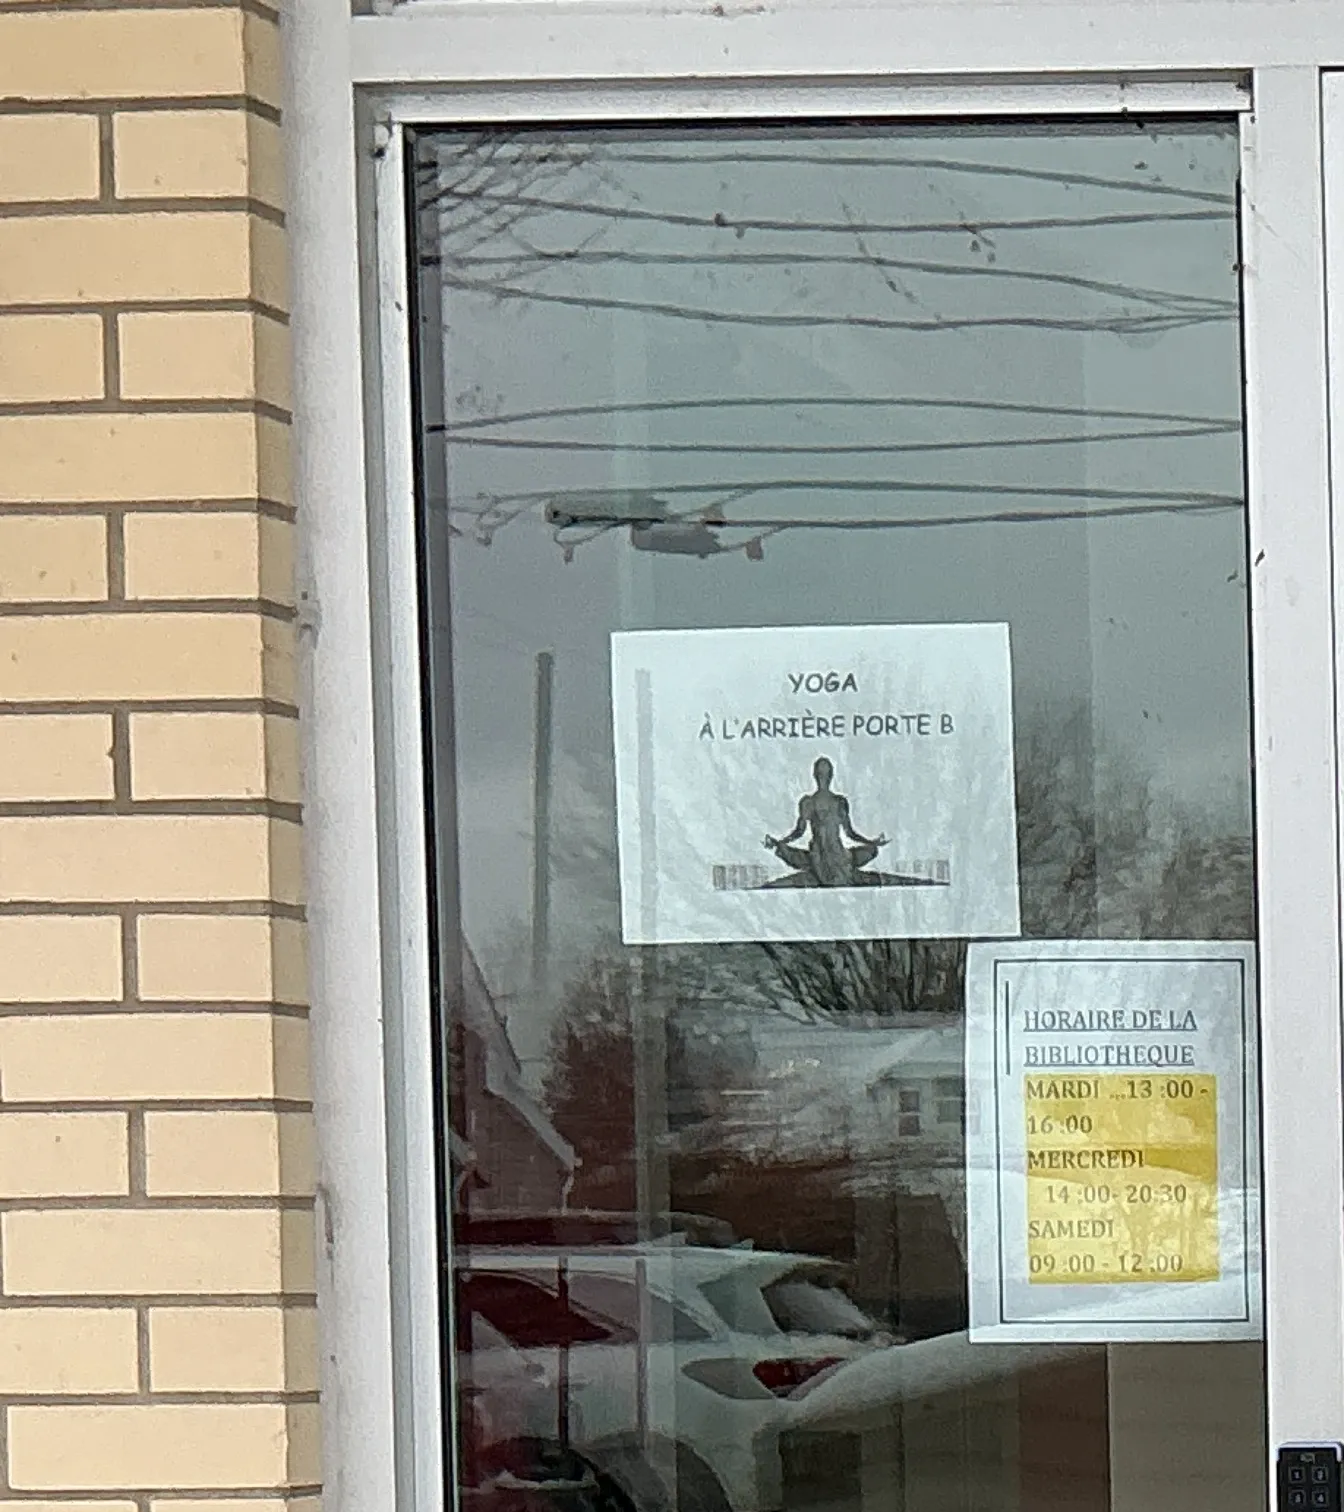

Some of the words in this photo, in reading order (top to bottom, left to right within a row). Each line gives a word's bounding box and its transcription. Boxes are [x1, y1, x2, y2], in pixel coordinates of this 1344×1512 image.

[787, 672, 858, 694] YOGA
[699, 714, 714, 739] À
[723, 709, 845, 739] L'ARRIÈRE
[853, 714, 931, 736] PORTE
[940, 714, 954, 734] B
[1024, 1010, 1124, 1032] HORAIRE
[1132, 1009, 1167, 1031] DE
[1169, 1009, 1198, 1031] LA
[1024, 1044, 1195, 1066] BIBLIOTHEQUE
[1026, 1080, 1100, 1099] MARDI
[1028, 1149, 1145, 1170] MERCREDI
[1029, 1219, 1114, 1238] SAMEDI
